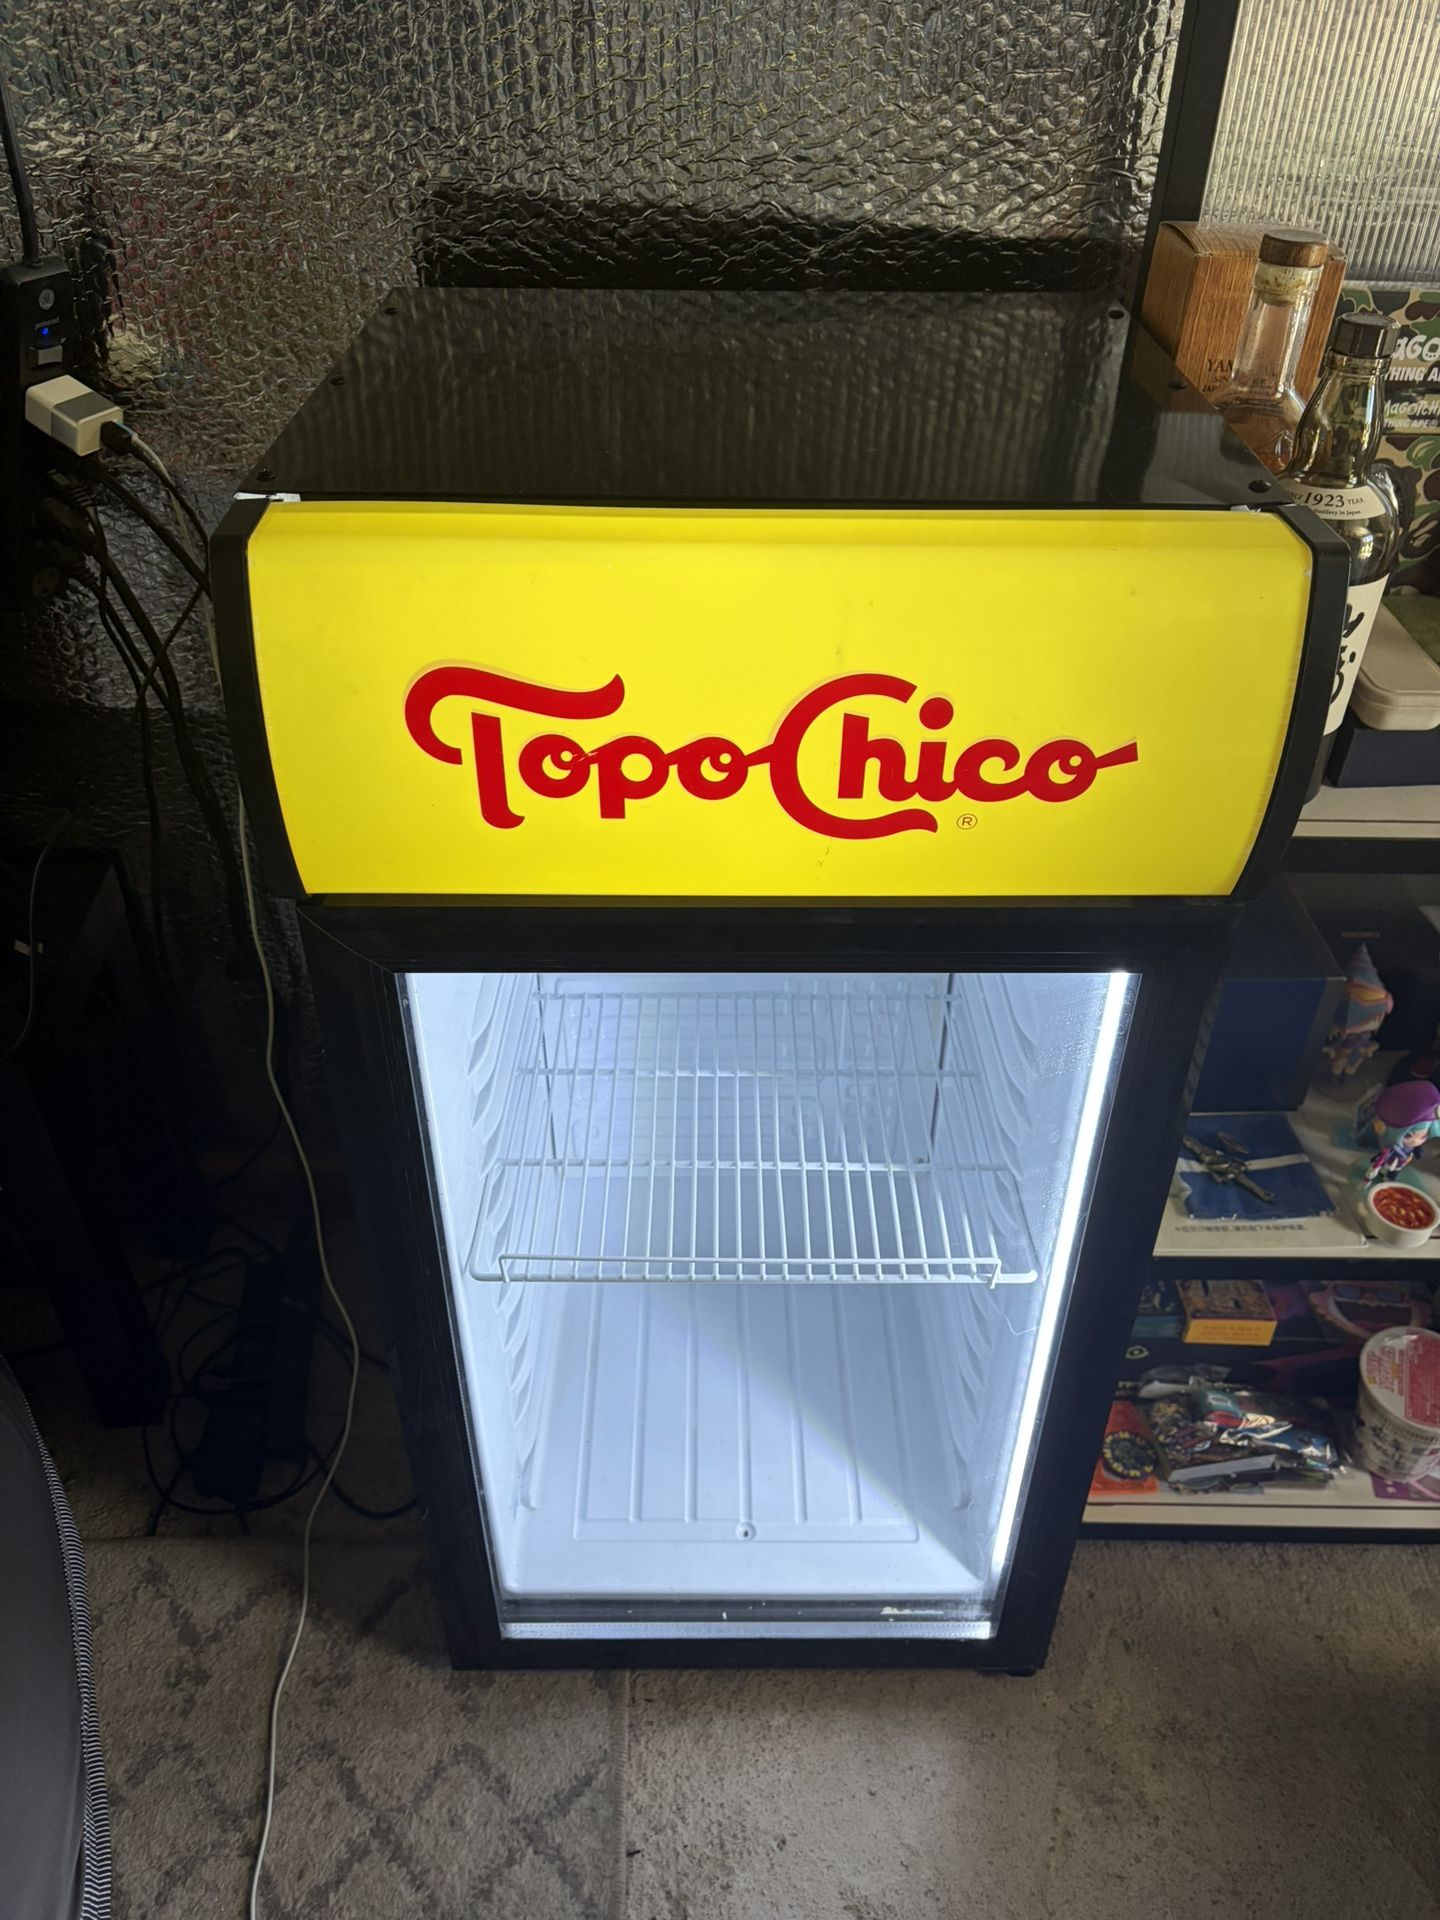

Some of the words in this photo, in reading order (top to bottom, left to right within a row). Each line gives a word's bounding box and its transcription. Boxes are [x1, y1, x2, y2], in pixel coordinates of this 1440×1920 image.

[1304, 491, 1345, 508] 1923
[1347, 497, 1365, 505] YEAR
[404, 666, 756, 829] Topo
[768, 673, 1138, 840] Chico
